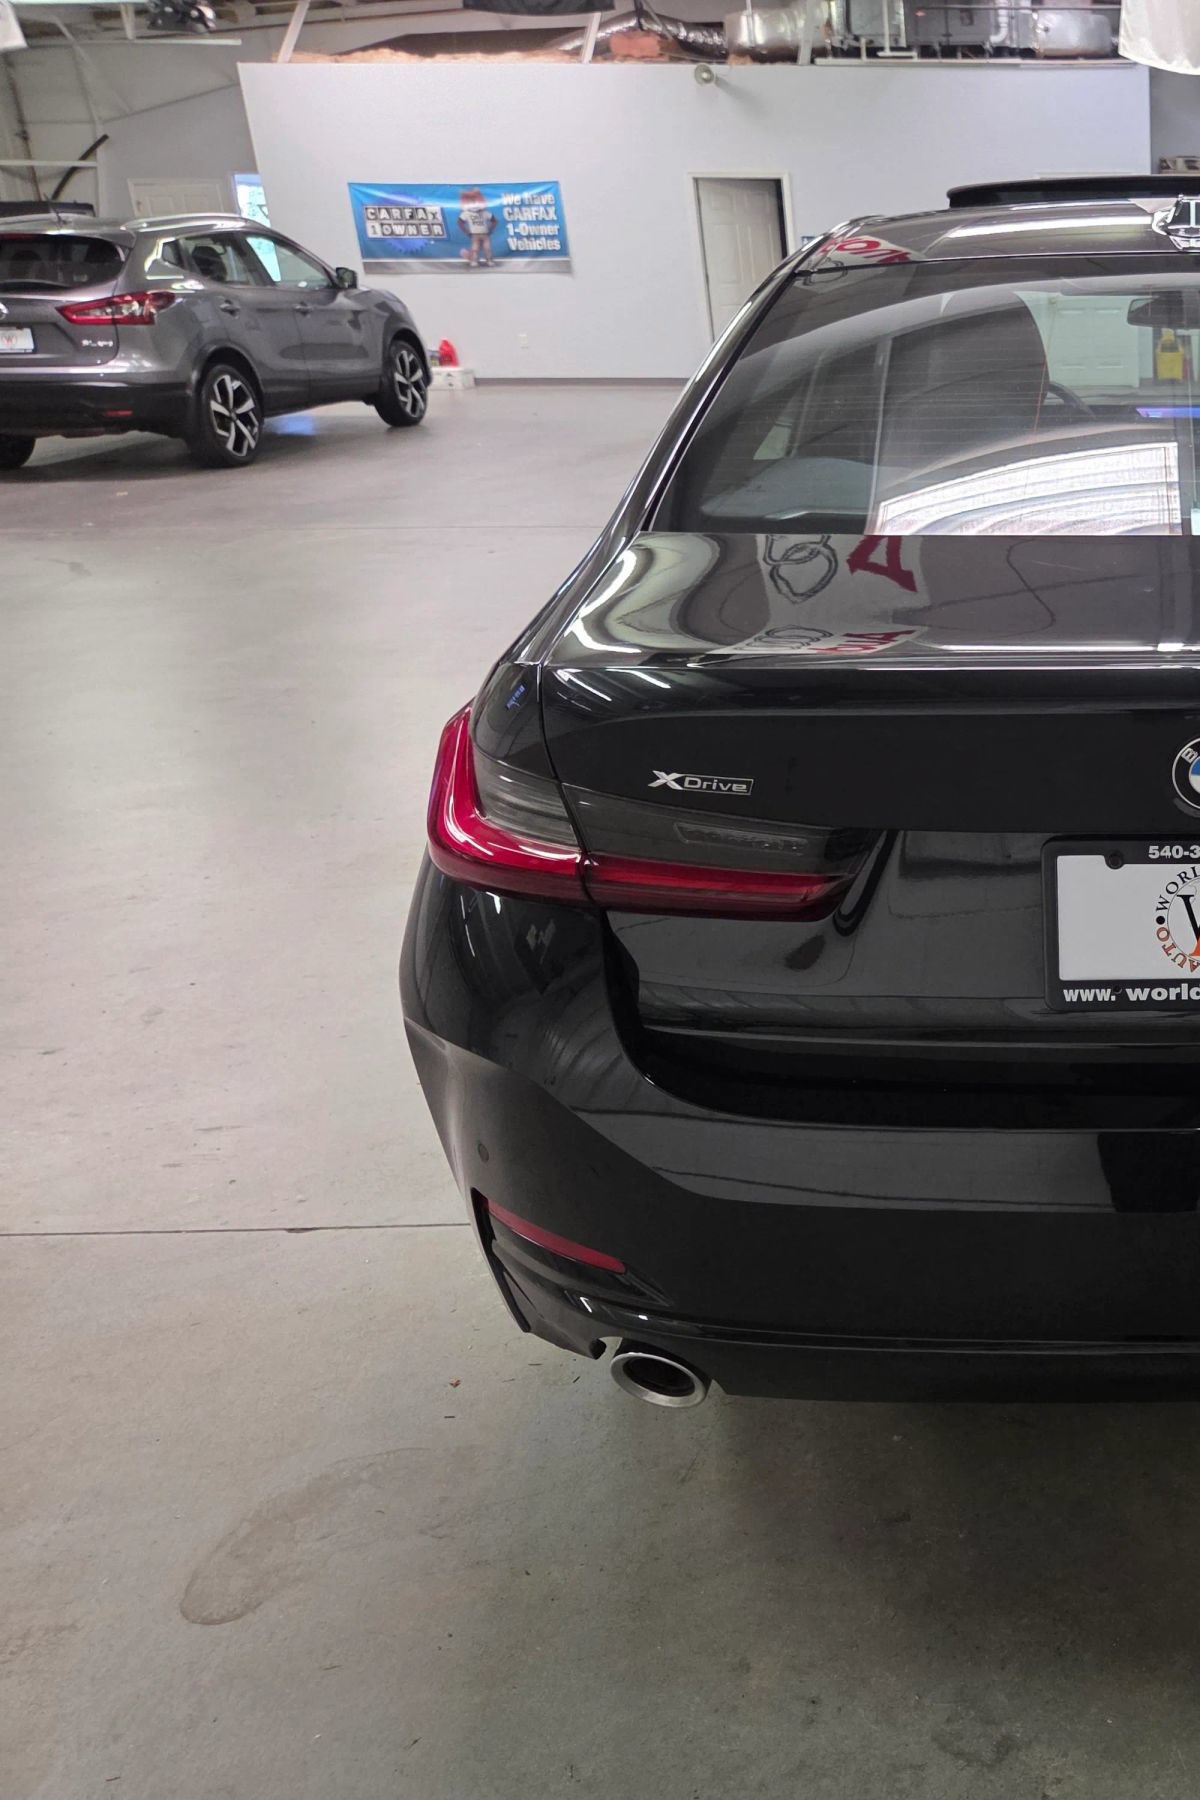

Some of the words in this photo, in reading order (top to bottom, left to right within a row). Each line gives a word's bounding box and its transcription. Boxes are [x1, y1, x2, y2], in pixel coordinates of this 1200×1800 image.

[366, 207, 440, 220] CARFAX
[503, 206, 557, 221] CARFAX
[506, 223, 560, 236] 1-Owner
[507, 237, 561, 250] Vehicles
[1156, 926, 1200, 973] AUTO
